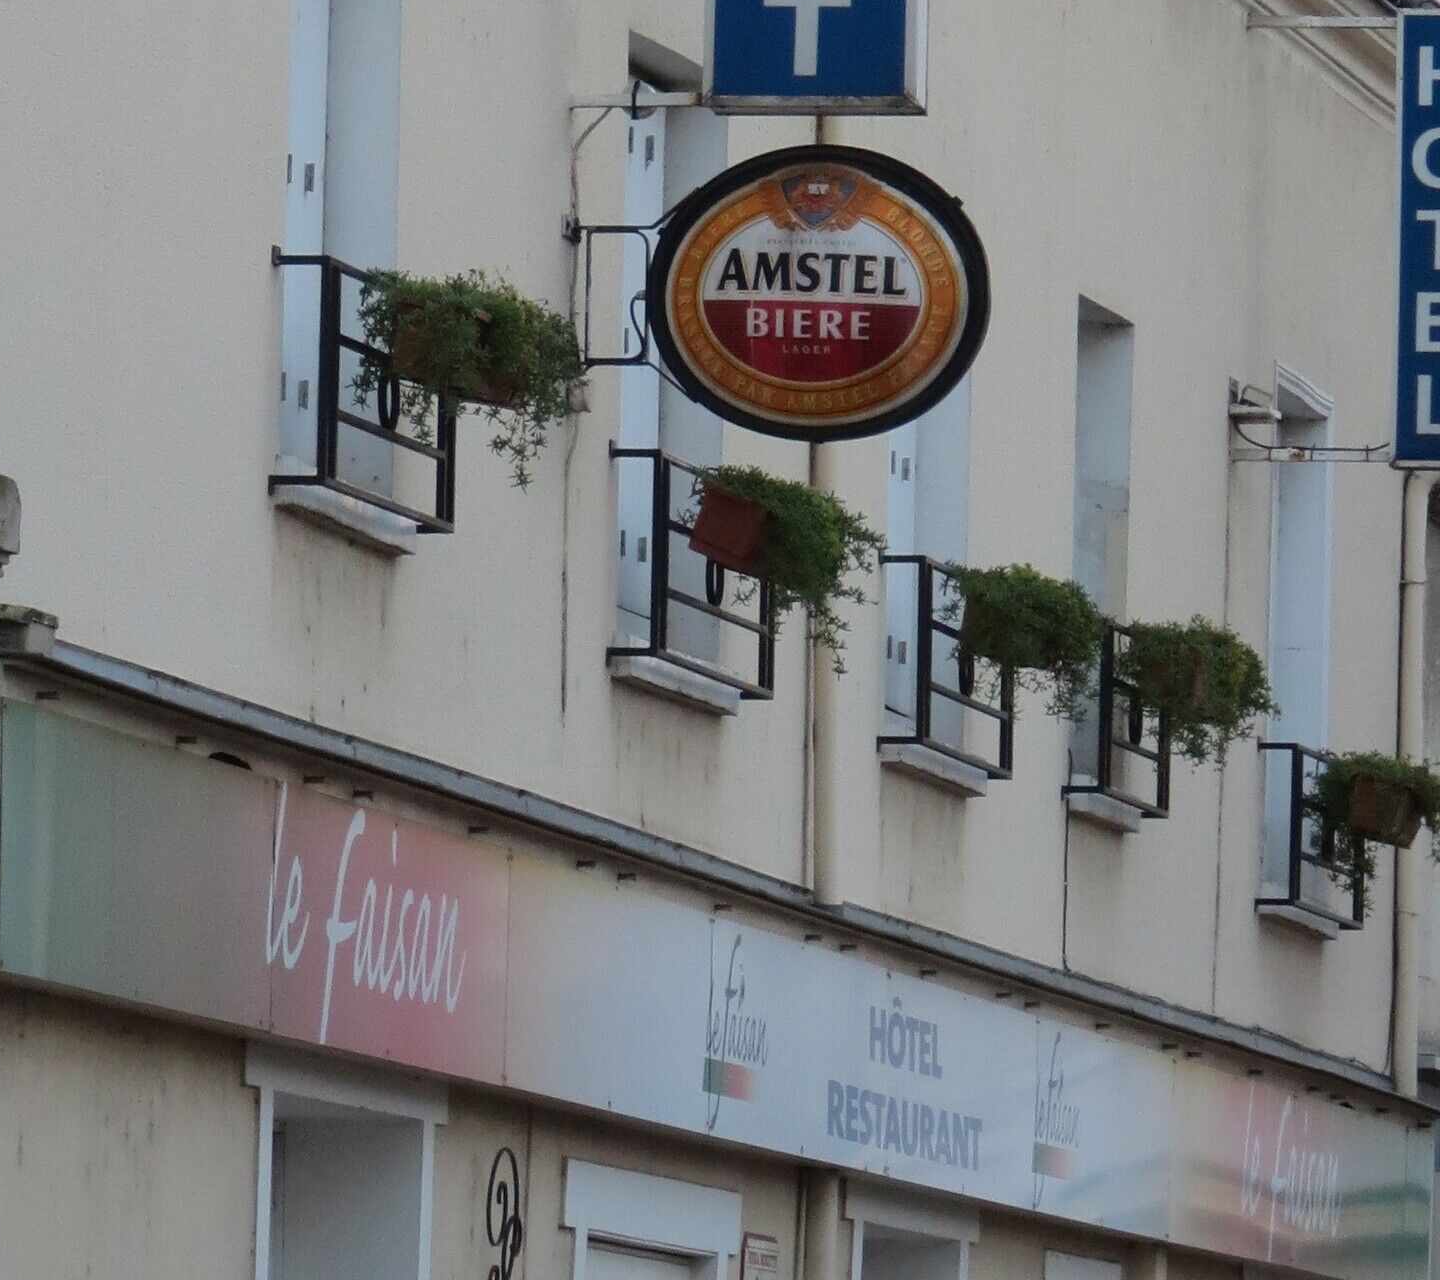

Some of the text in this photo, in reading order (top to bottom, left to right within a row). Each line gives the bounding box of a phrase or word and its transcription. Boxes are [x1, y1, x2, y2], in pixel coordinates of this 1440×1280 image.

[716, 248, 907, 296] AMSTEL
[746, 308, 870, 340] BIERE
[265, 780, 466, 1045] le faisan
[869, 996, 942, 1080] HÔTEL
[827, 1080, 982, 1170] RESTAURANT
